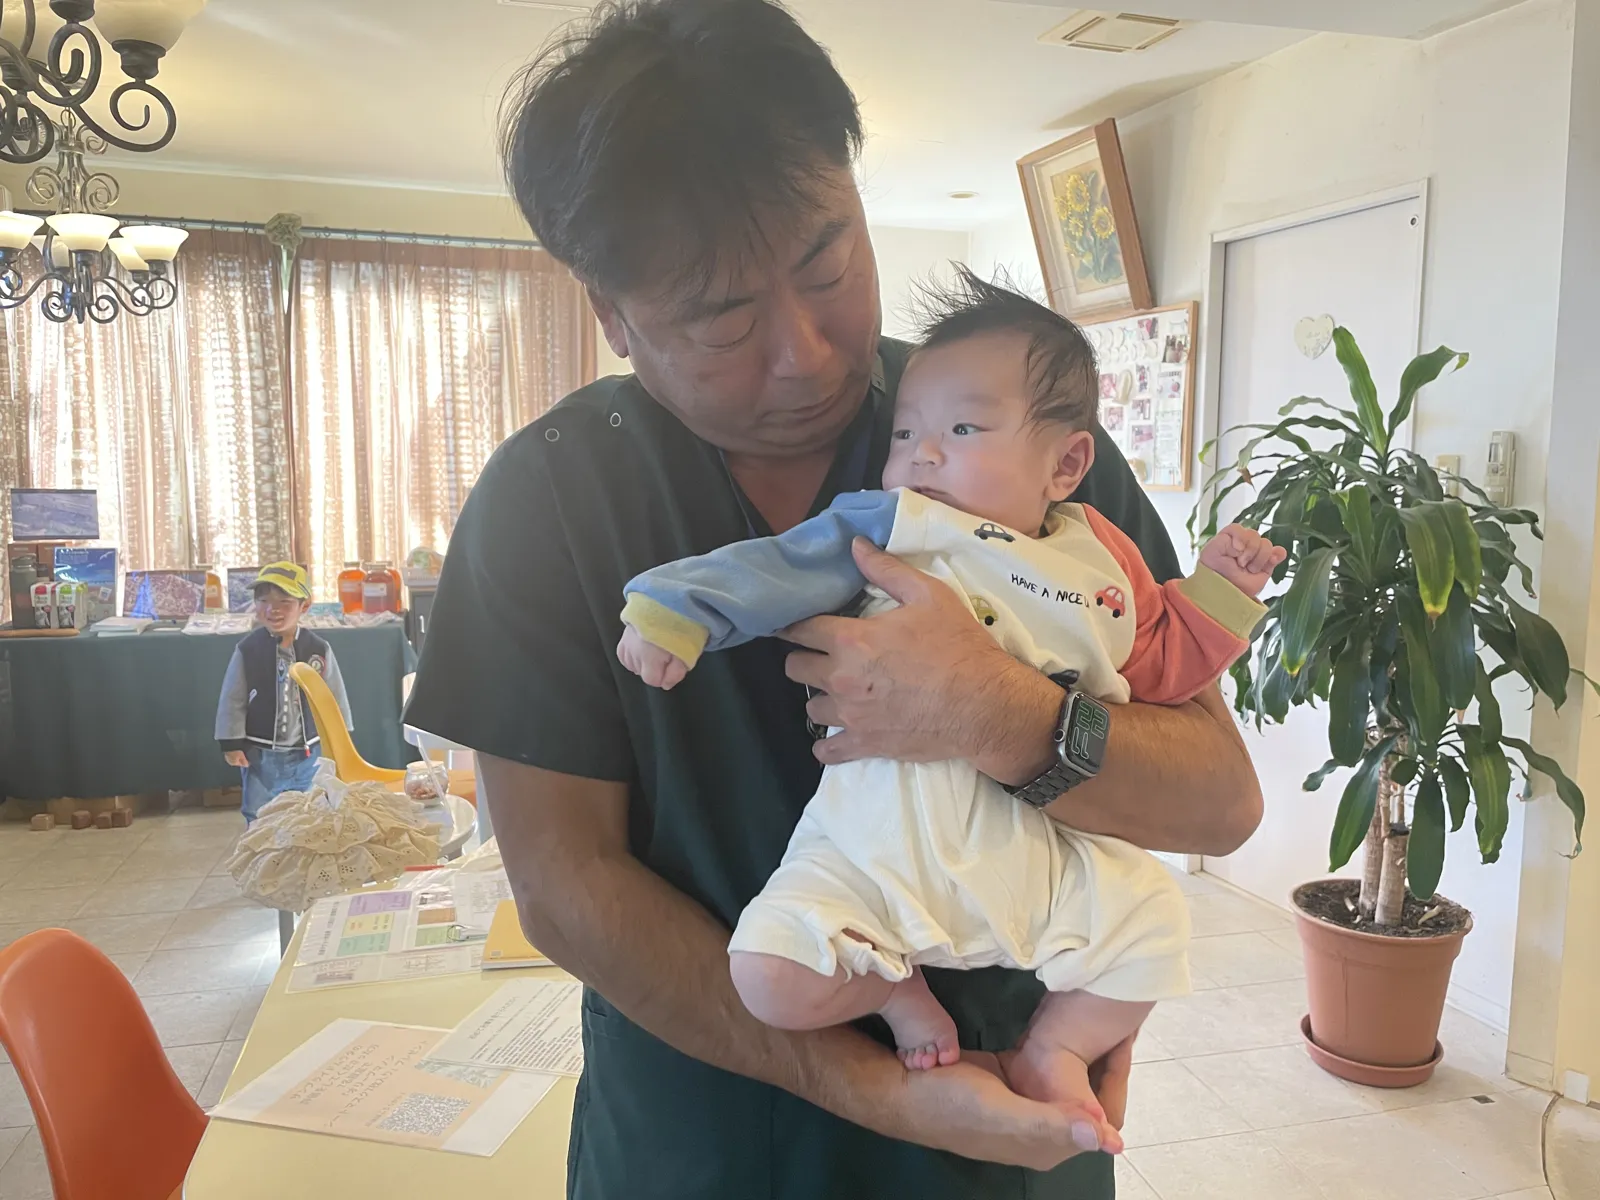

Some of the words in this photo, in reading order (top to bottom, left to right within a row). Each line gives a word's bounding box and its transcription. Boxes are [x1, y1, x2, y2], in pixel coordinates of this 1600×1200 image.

[1011, 573, 1038, 594] HAVE
[1041, 587, 1049, 598] A
[1055, 589, 1083, 605] NICE
